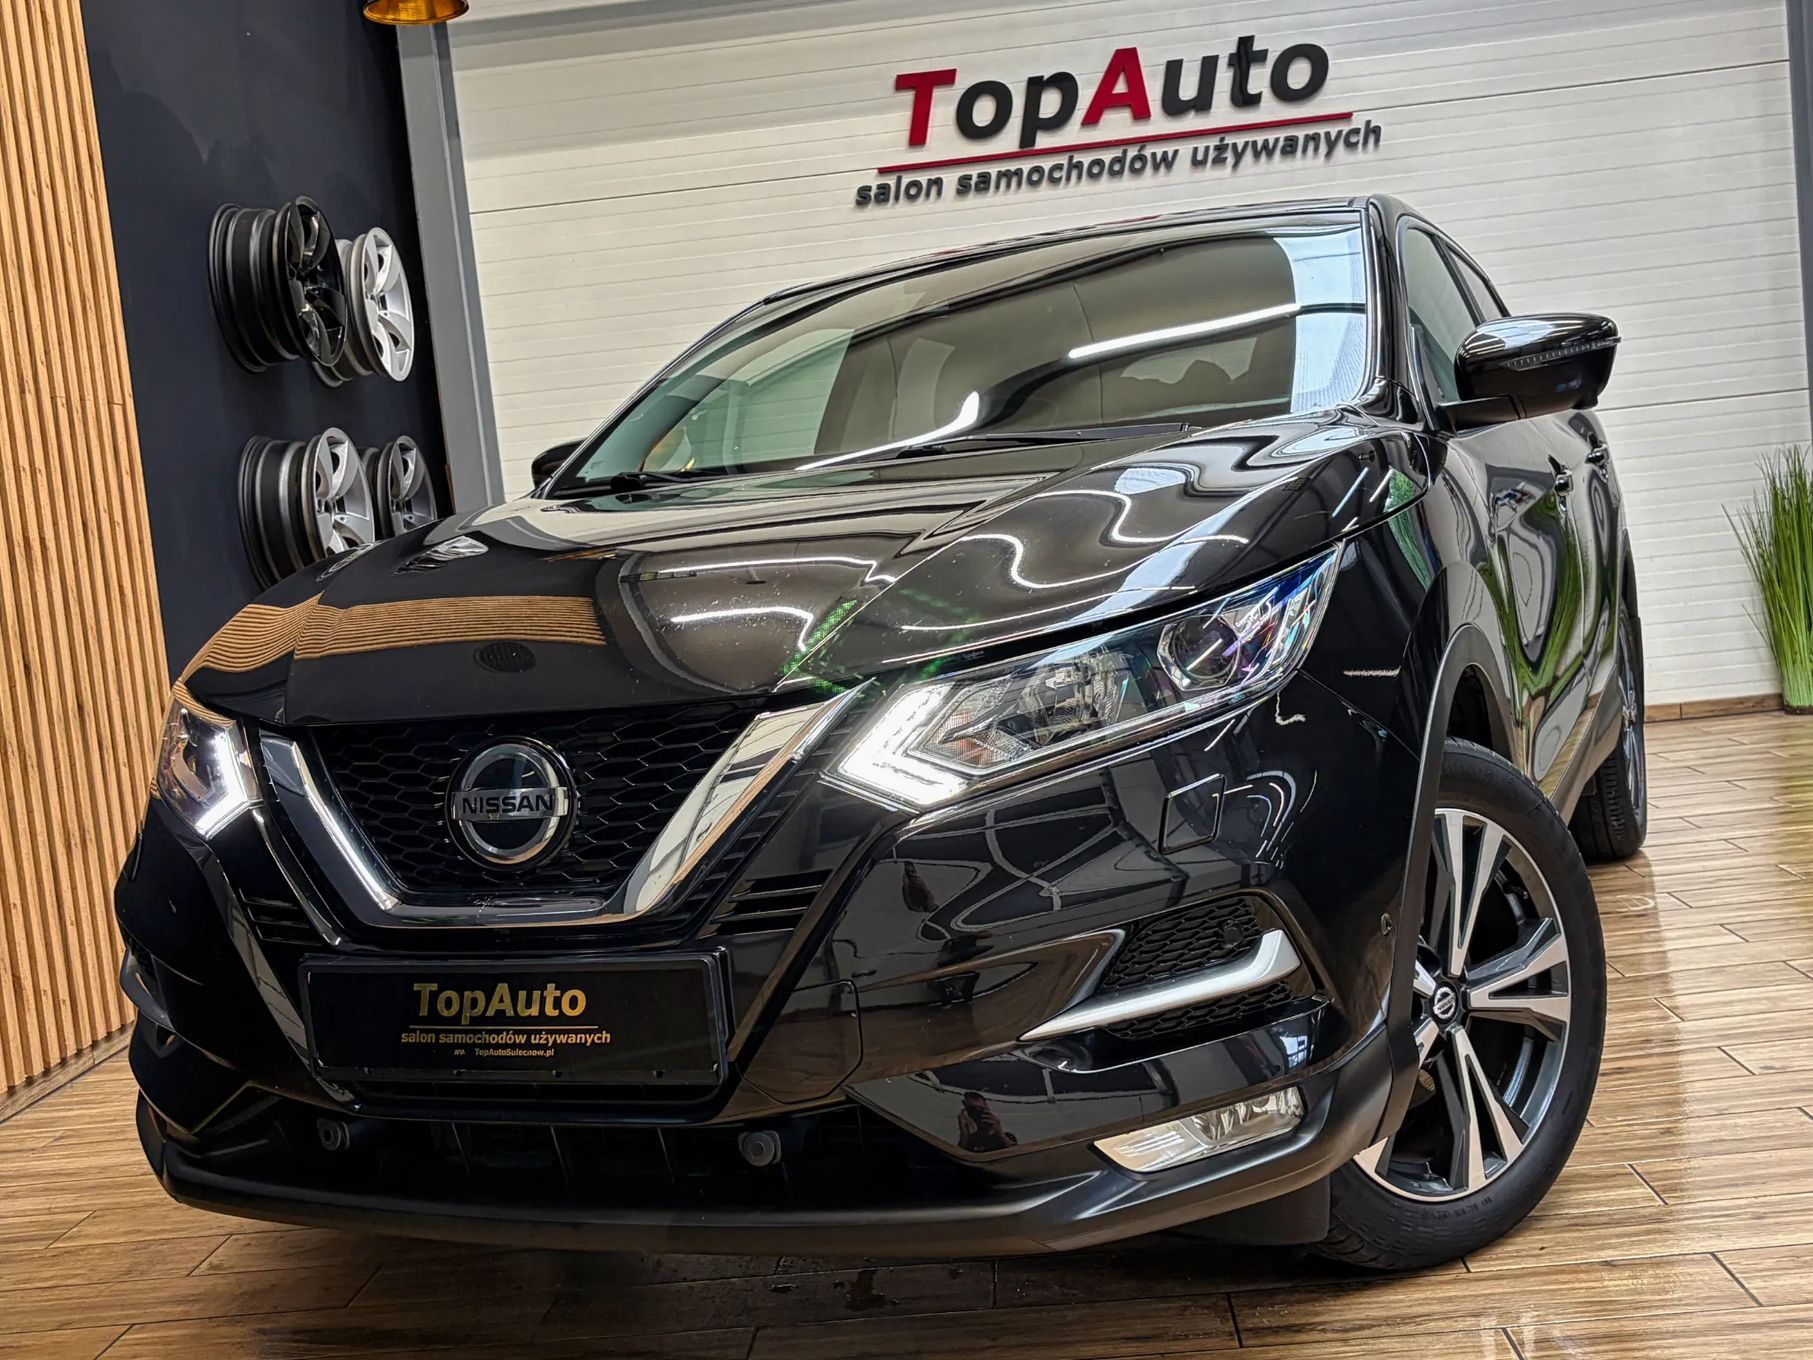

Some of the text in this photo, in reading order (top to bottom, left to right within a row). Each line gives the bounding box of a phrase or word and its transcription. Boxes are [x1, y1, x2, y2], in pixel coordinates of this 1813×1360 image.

[895, 35, 1329, 149] TopAuto
[855, 119, 1382, 205] salon samochodów używanych
[462, 794, 552, 814] NISSAN
[413, 982, 587, 1025] TopAuto
[401, 1030, 611, 1046] salon samochodów używanych
